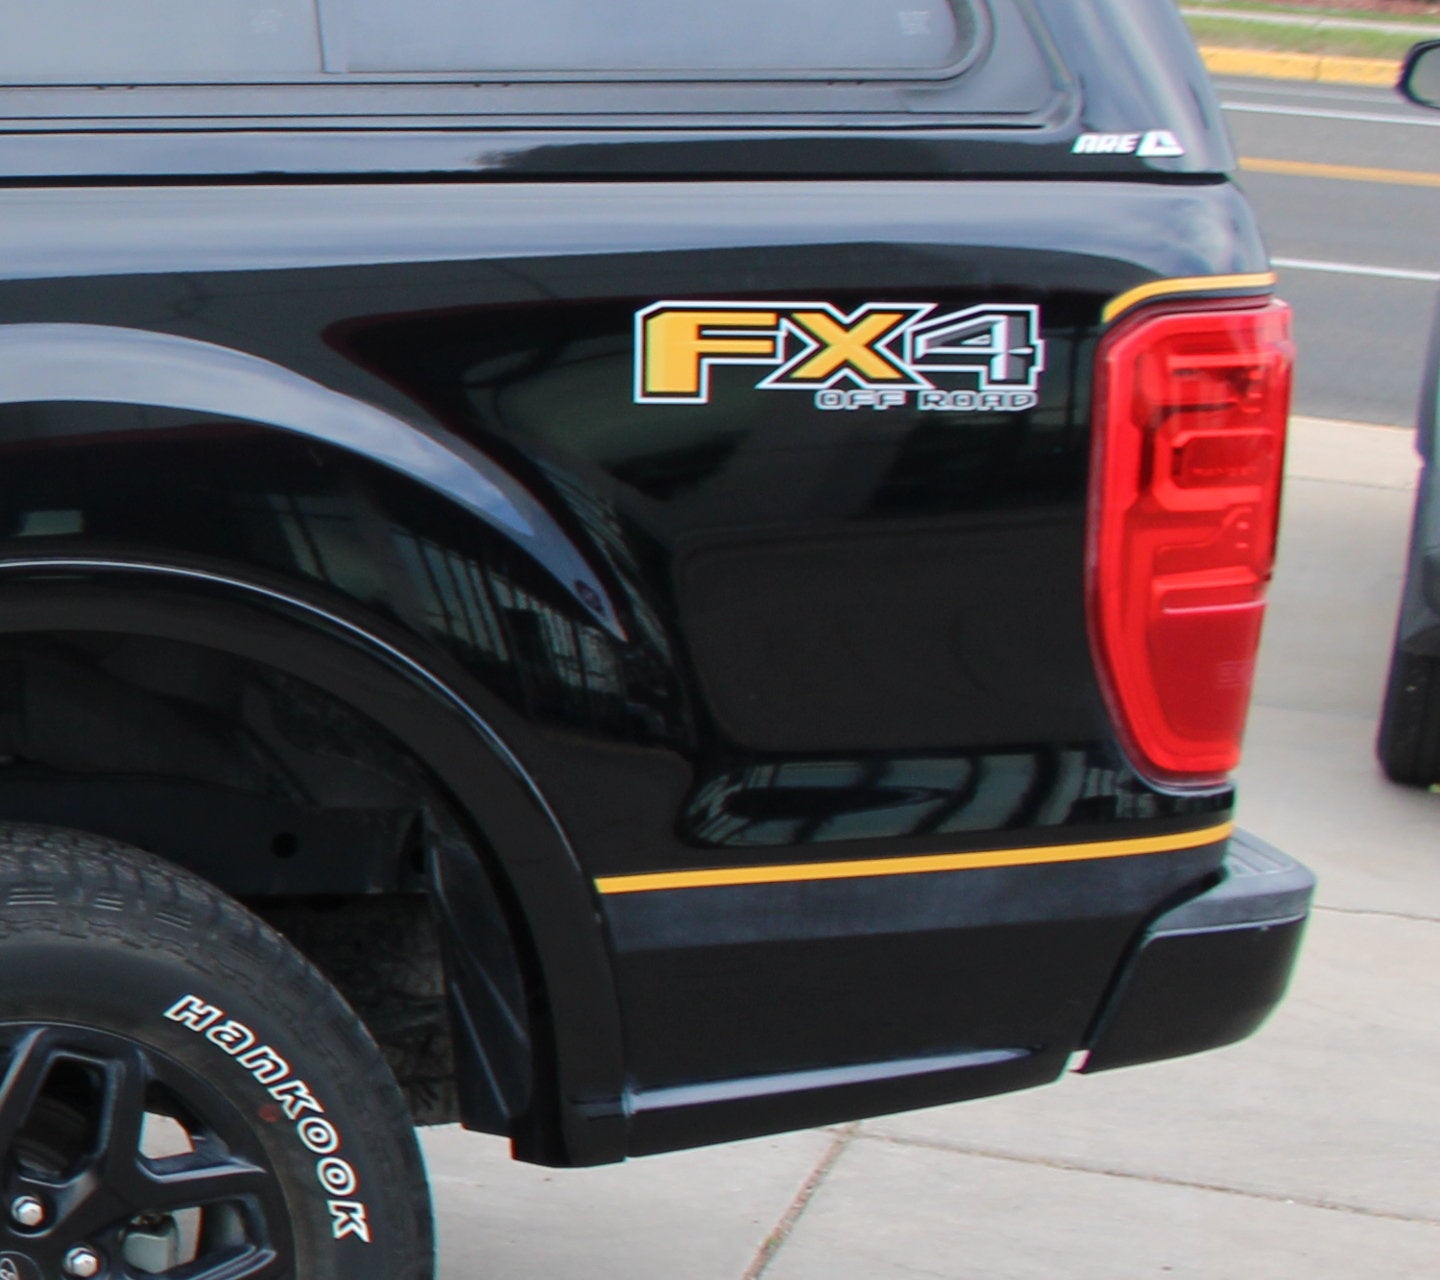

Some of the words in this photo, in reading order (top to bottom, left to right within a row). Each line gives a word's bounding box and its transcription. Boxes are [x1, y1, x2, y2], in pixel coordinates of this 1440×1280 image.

[634, 300, 1044, 404] FX4
[814, 389, 907, 410] OFF
[917, 390, 1038, 411] ROAD
